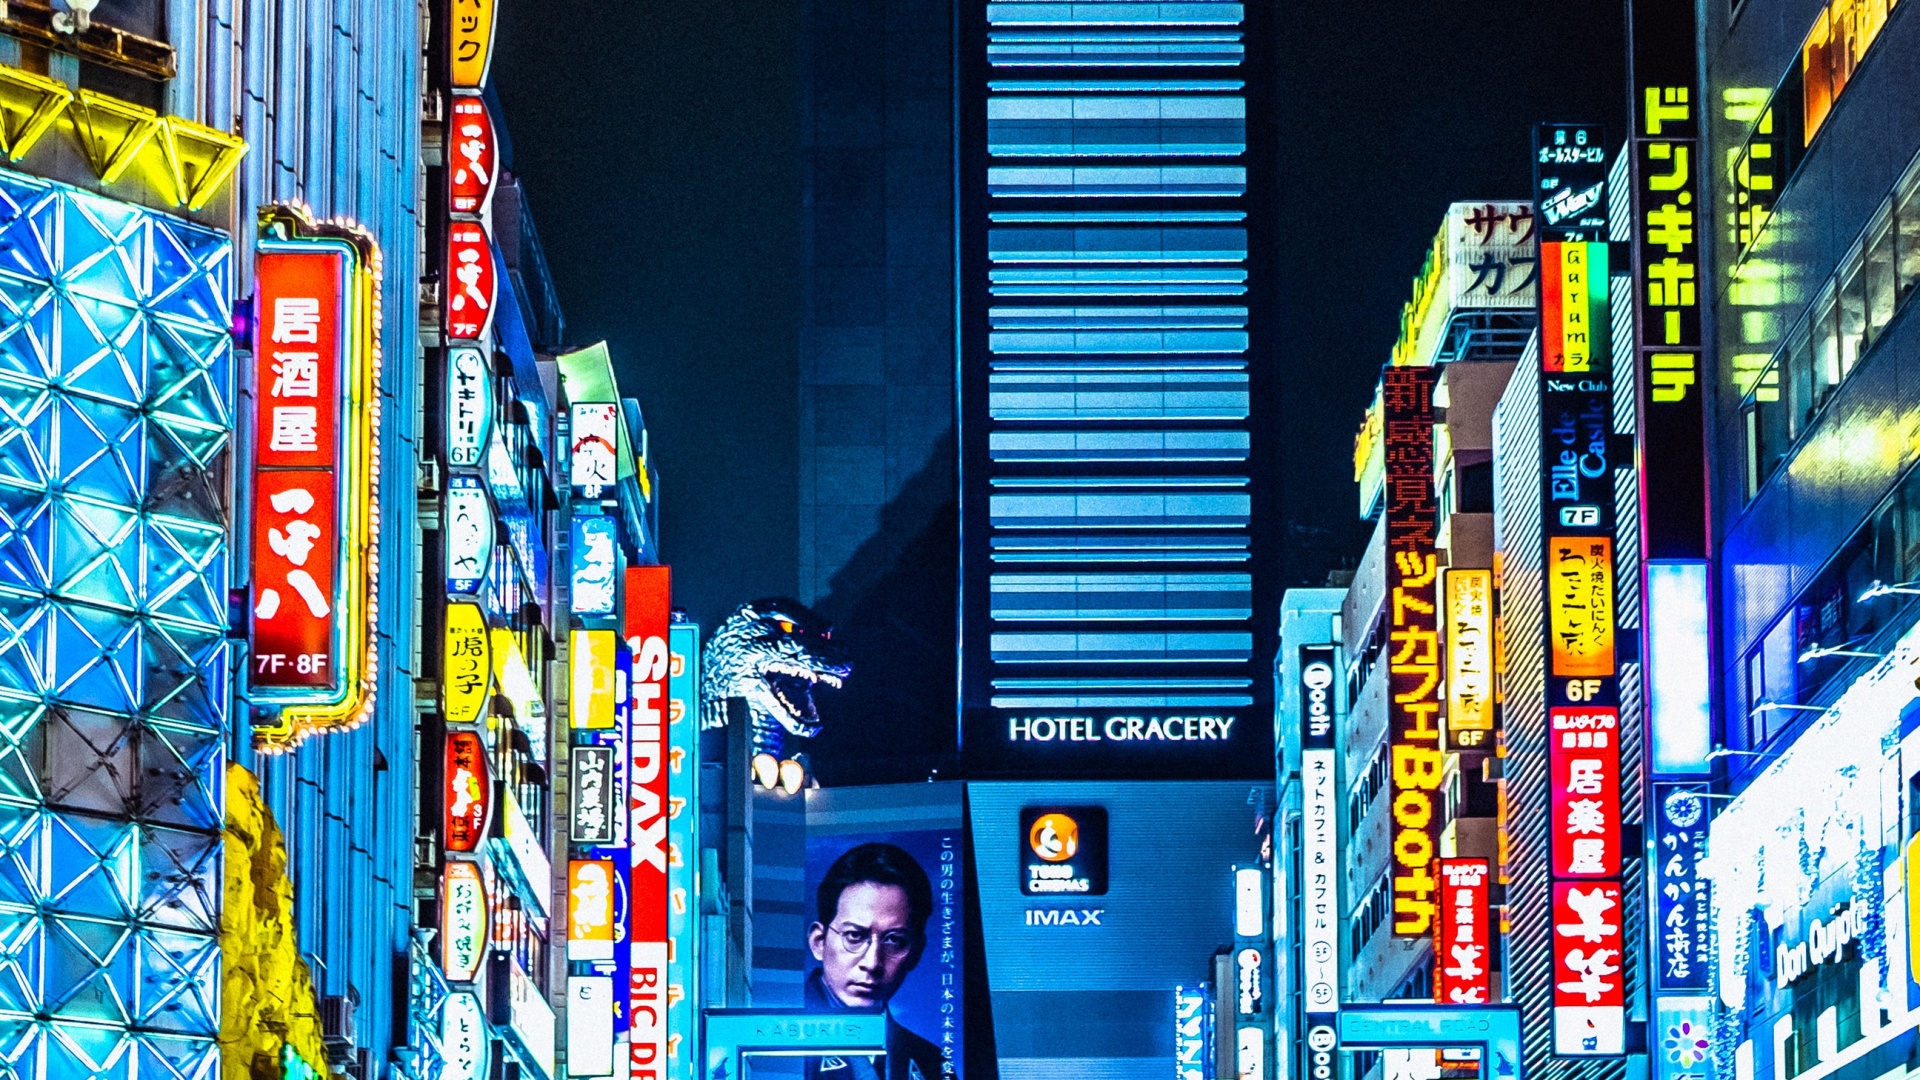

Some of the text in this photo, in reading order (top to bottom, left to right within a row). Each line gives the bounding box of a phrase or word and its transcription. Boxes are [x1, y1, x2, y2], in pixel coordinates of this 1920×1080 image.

[1645, 87, 1695, 402] ドン・キホーテ
[453, 323, 477, 335] 7F
[270, 298, 320, 451] 居酒屋
[1547, 380, 1608, 392] New Club
[451, 446, 480, 462] 6F
[1552, 450, 1579, 501] Elle
[1564, 510, 1596, 525] 7F
[455, 580, 473, 591] 5F
[1565, 680, 1602, 702] 6F
[1009, 716, 1235, 741] HOTEL GRACERY
[1457, 731, 1484, 747] 6F
[632, 636, 668, 874] SHIDAX
[1566, 759, 1607, 874] 居楽屋
[1025, 909, 1103, 926] IMAX
[1663, 831, 1692, 979] かんかん商店
[940, 837, 955, 1080] この男の生きざまが、日本の未来を変
[1776, 941, 1807, 990] Don
[630, 966, 658, 1028] BIC
